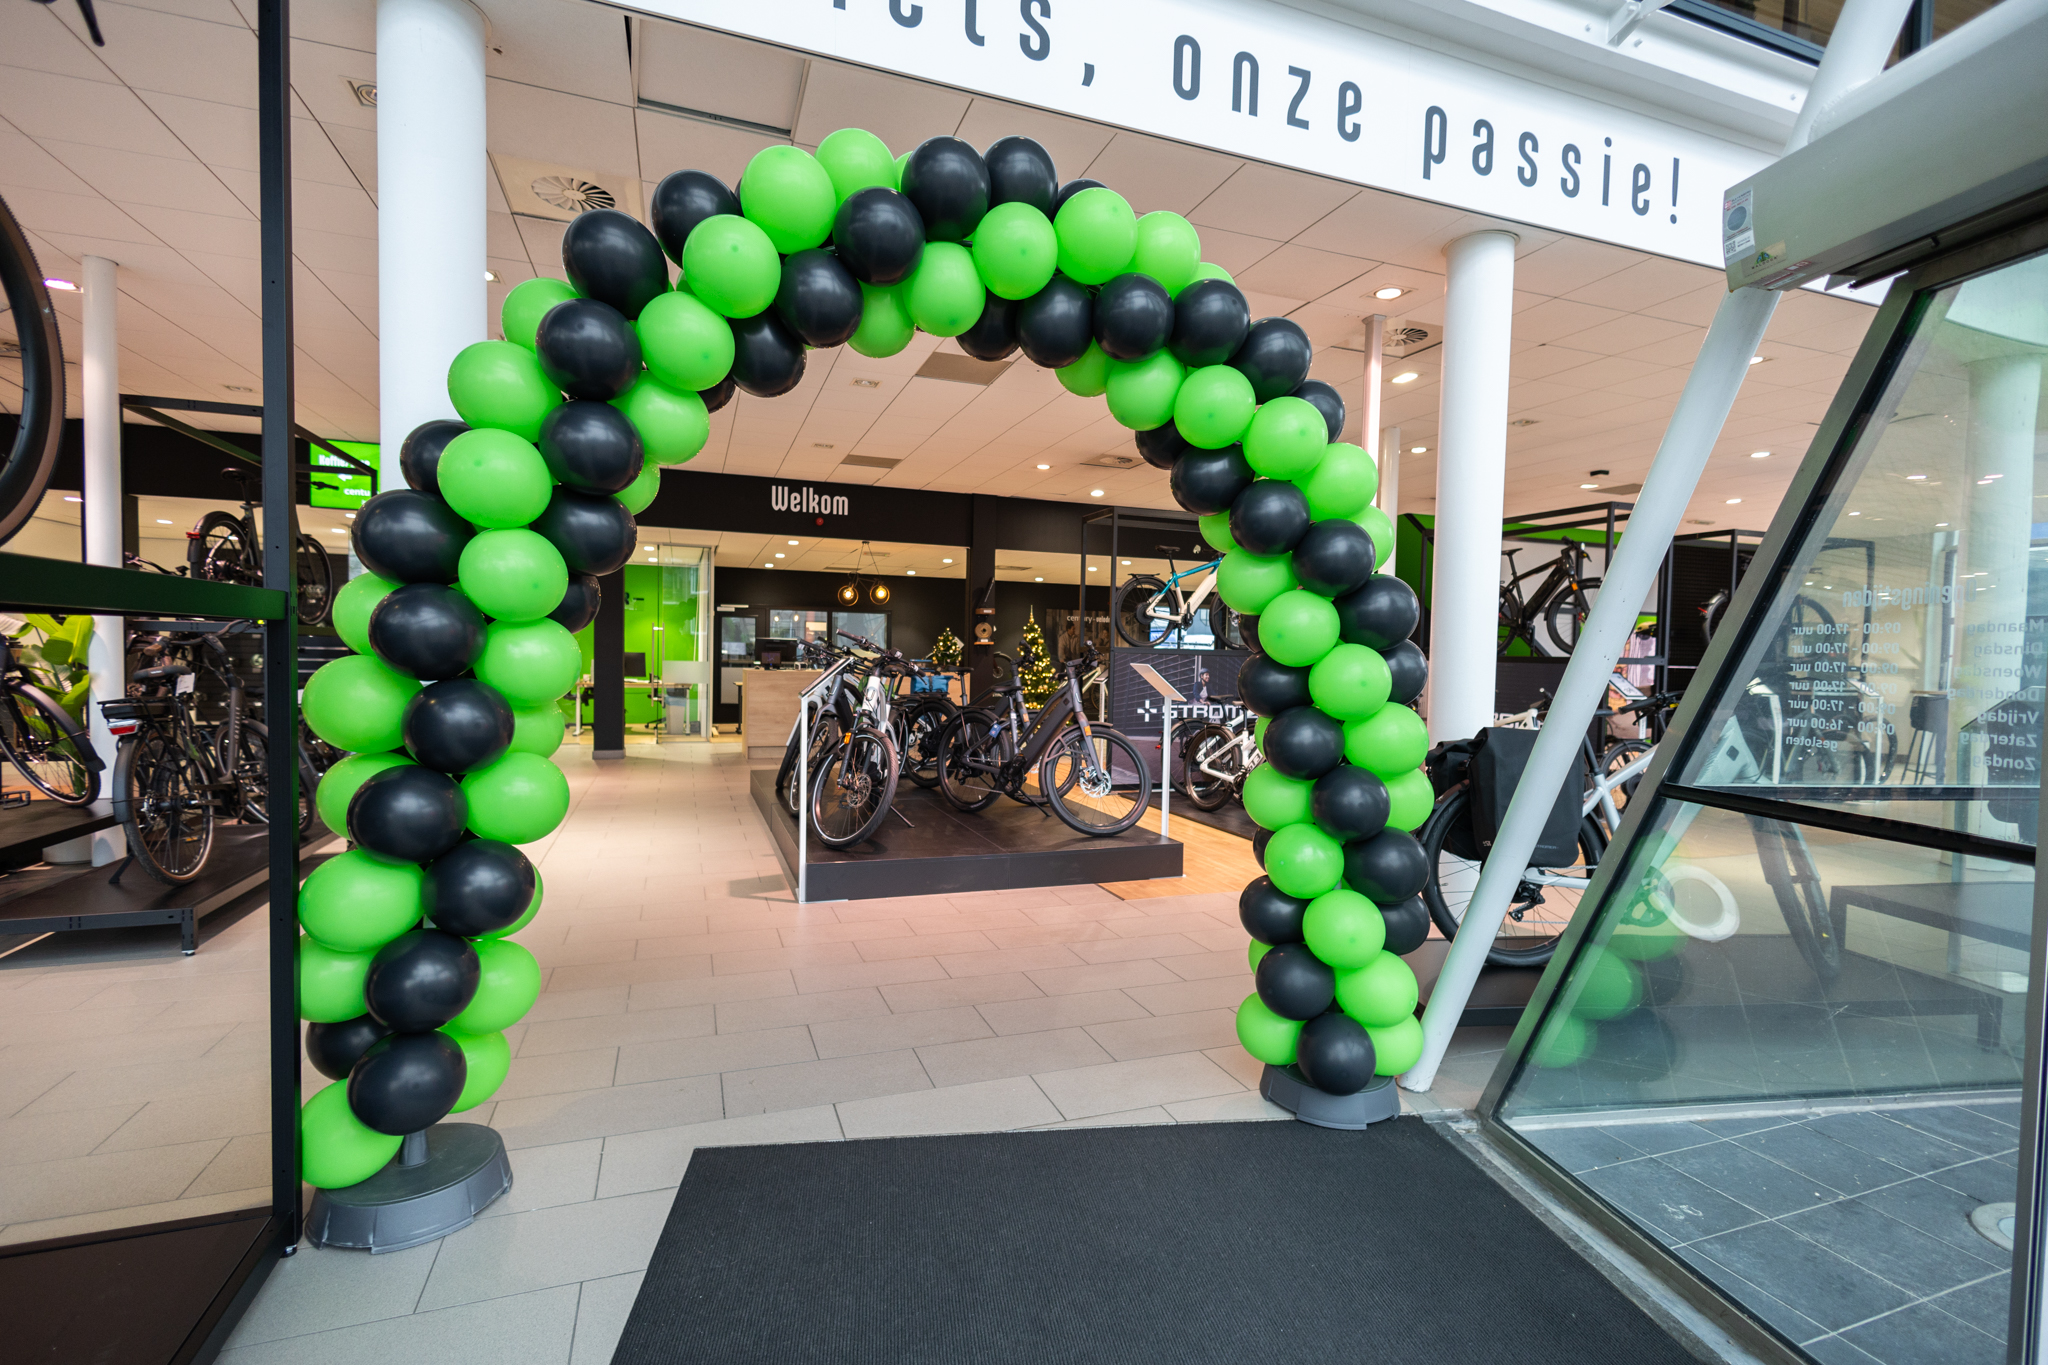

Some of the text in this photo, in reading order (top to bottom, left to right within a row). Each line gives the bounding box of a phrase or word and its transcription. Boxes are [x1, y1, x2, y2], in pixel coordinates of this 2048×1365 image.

[1173, 34, 1362, 142] onze
[1423, 105, 1680, 224] passie!
[771, 485, 849, 516] Welkom
